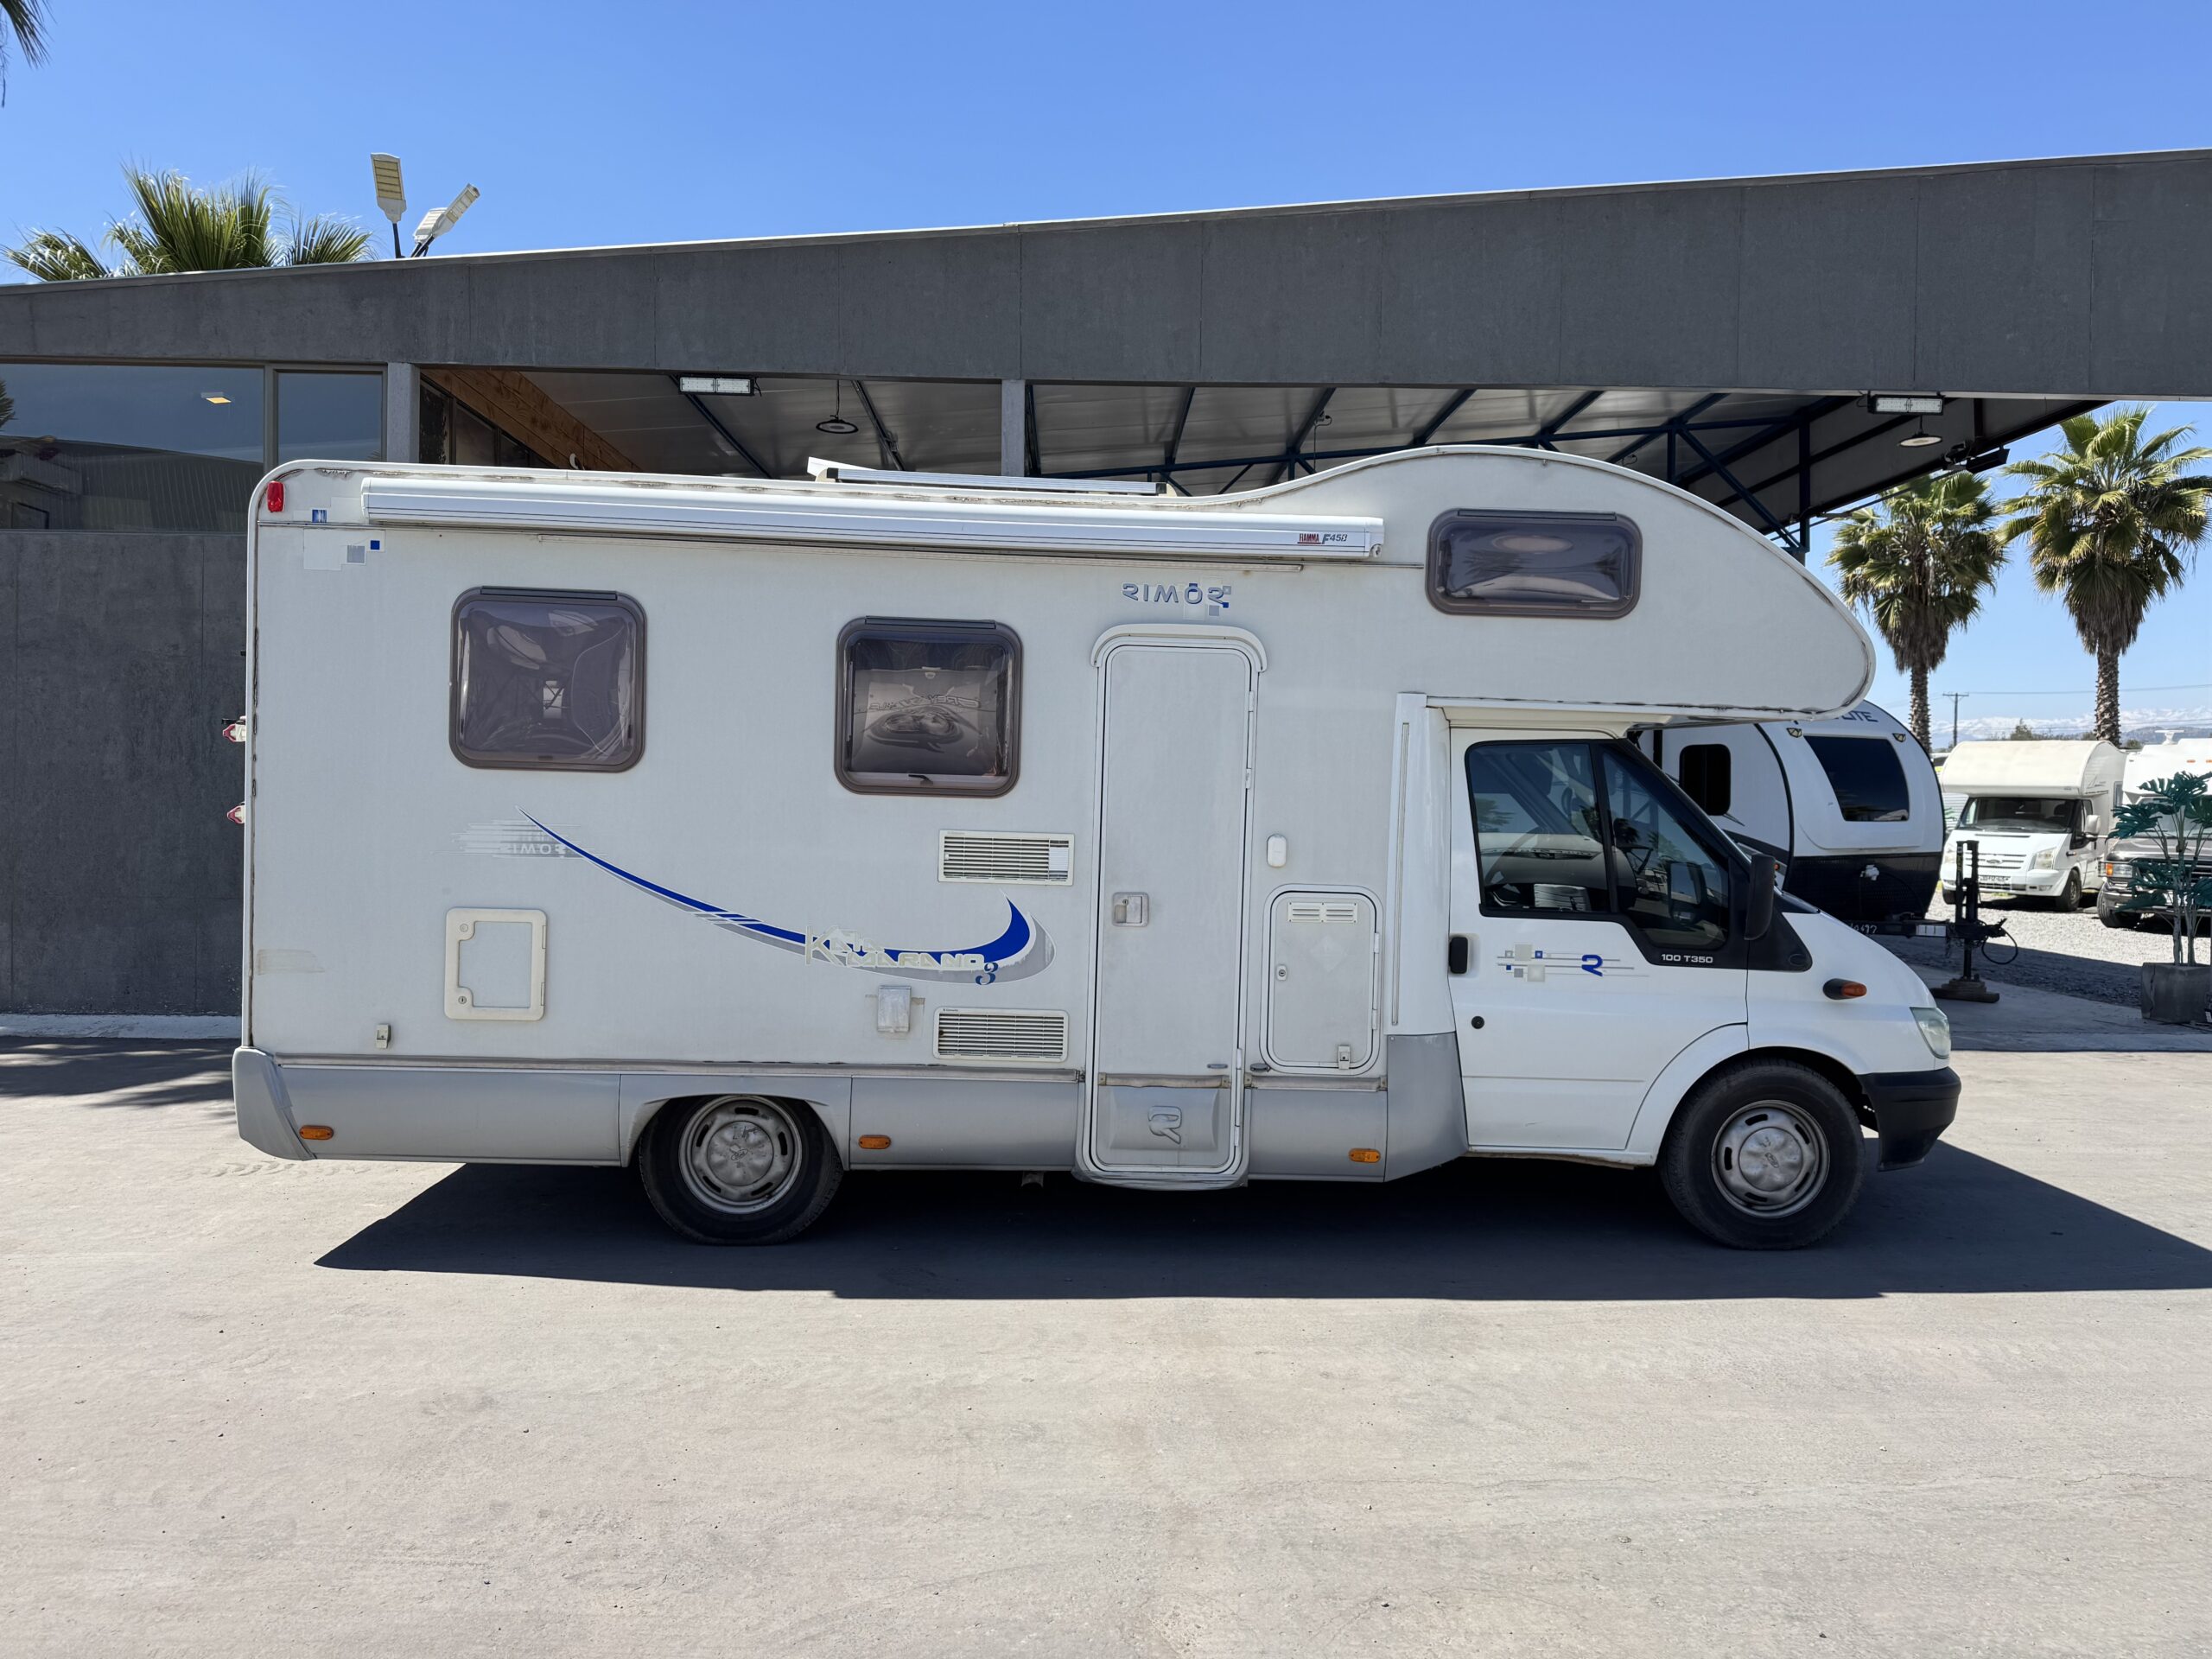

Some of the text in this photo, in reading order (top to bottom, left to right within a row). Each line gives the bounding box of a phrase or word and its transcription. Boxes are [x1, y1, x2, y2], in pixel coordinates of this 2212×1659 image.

[1299, 533, 1319, 543] FIAMMA
[1661, 953, 1713, 963] 100 T350
